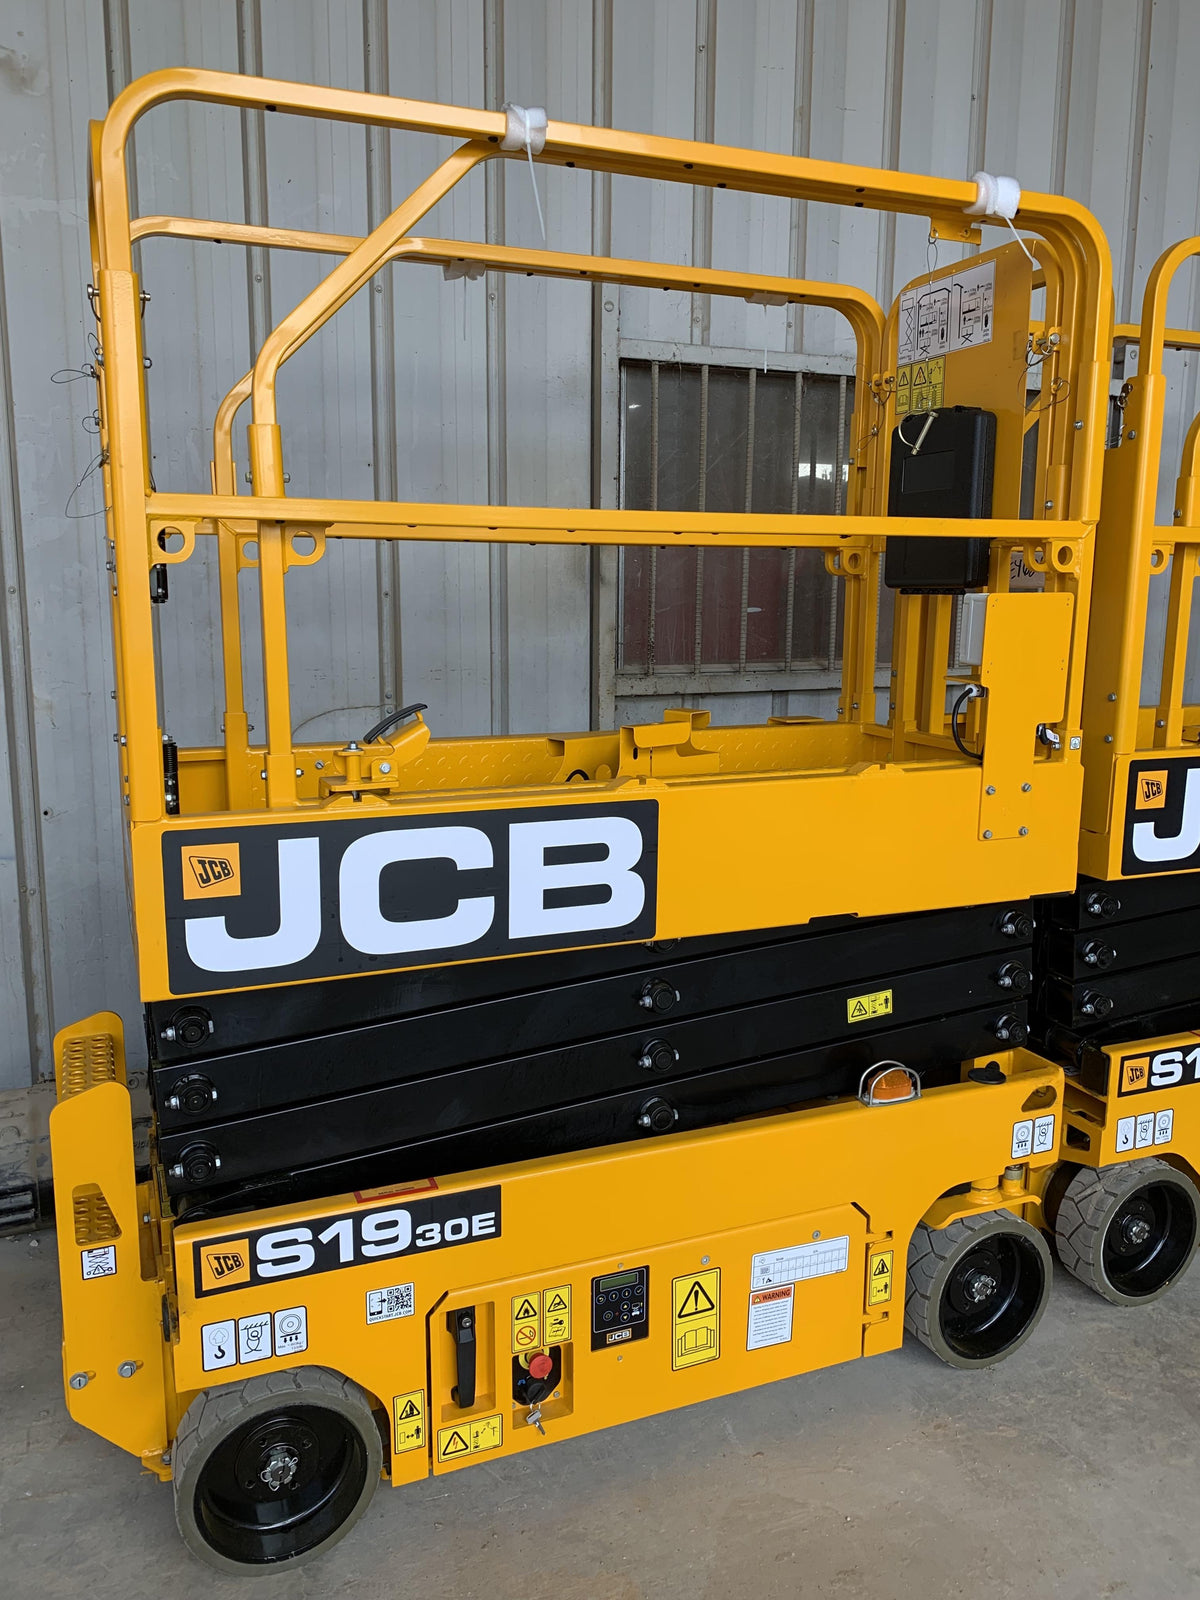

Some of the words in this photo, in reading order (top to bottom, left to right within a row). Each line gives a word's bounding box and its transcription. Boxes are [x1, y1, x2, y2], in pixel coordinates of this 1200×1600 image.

[1145, 781, 1162, 799] JCB
[197, 859, 231, 884] JCB
[185, 816, 646, 973] JCB
[1129, 1067, 1144, 1083] JCB
[213, 1255, 242, 1276] JCB
[762, 1289, 791, 1301] WARNING
[368, 1309, 413, 1323] QUICKSTART.JCB.COM
[608, 1329, 631, 1342] JCB
